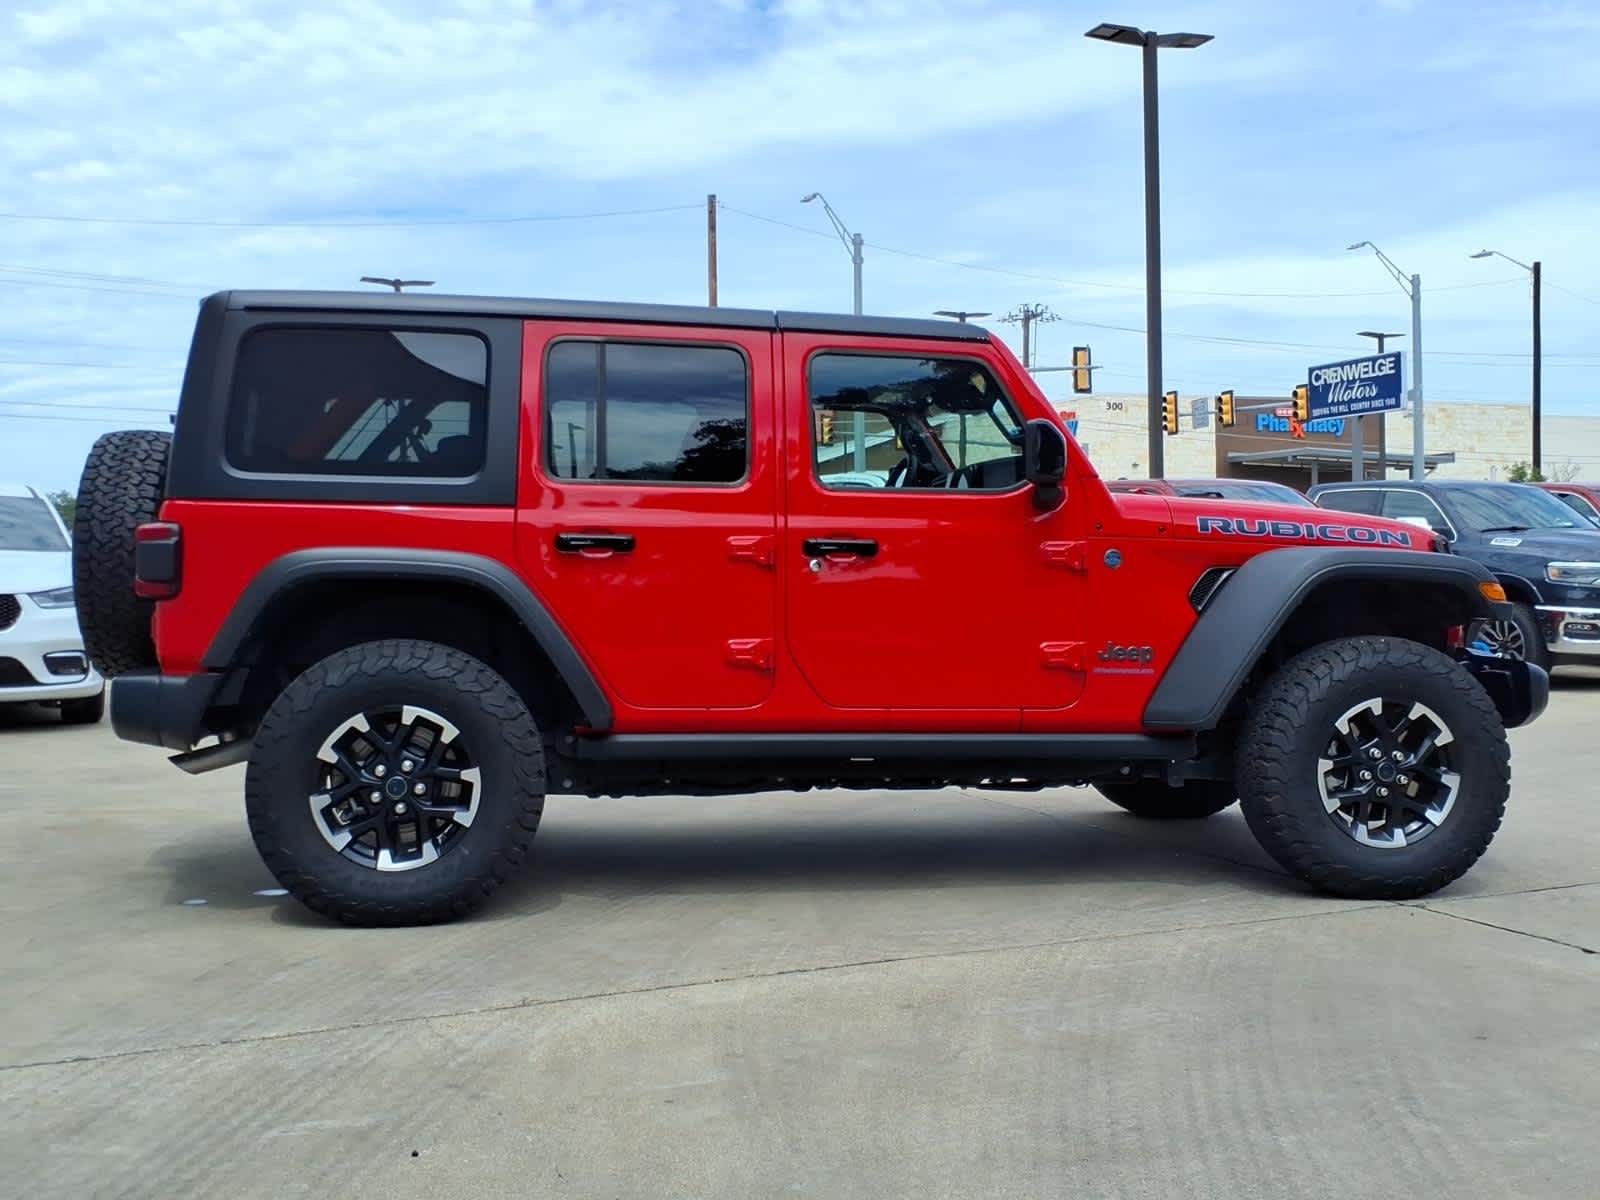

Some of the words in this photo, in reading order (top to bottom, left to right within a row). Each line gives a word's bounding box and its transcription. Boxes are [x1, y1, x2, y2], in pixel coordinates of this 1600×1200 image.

[1312, 357, 1396, 386] CRENWELGE
[1328, 380, 1378, 403] Motors
[1106, 402, 1123, 411] 300
[1350, 401, 1370, 411] COUNTRY
[1196, 515, 1412, 547] RUBICON
[1097, 640, 1153, 665] Jeep
